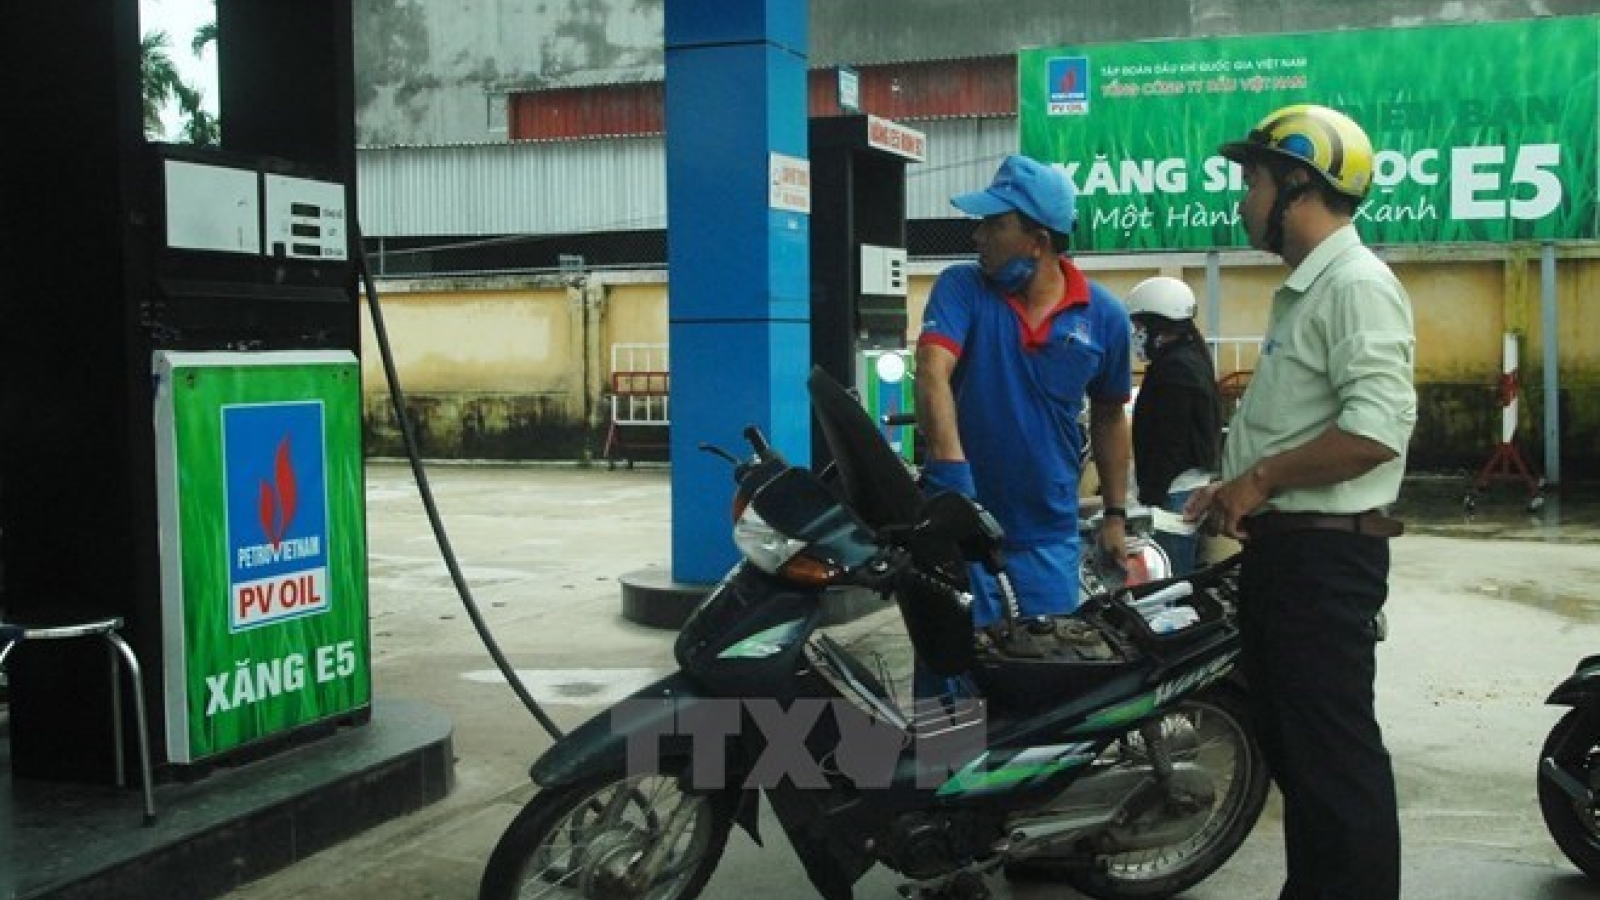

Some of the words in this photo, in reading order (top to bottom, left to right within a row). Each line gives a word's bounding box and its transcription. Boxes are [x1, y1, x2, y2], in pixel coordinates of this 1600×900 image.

[1233, 60, 1253, 71] GIA
[1280, 57, 1307, 68] NAM
[1186, 80, 1203, 94] TY
[1273, 75, 1307, 91] NAM
[1203, 155, 1248, 192] SI
[1373, 148, 1438, 193] ỌC
[1451, 143, 1562, 220] E5
[1093, 203, 1154, 236] Một
[1352, 197, 1438, 222] Xanh
[237, 535, 321, 569] PETROVIETNAM
[239, 583, 275, 619] PV
[280, 575, 321, 608] OIL
[205, 653, 305, 716] XĂNG
[316, 640, 356, 684] E5
